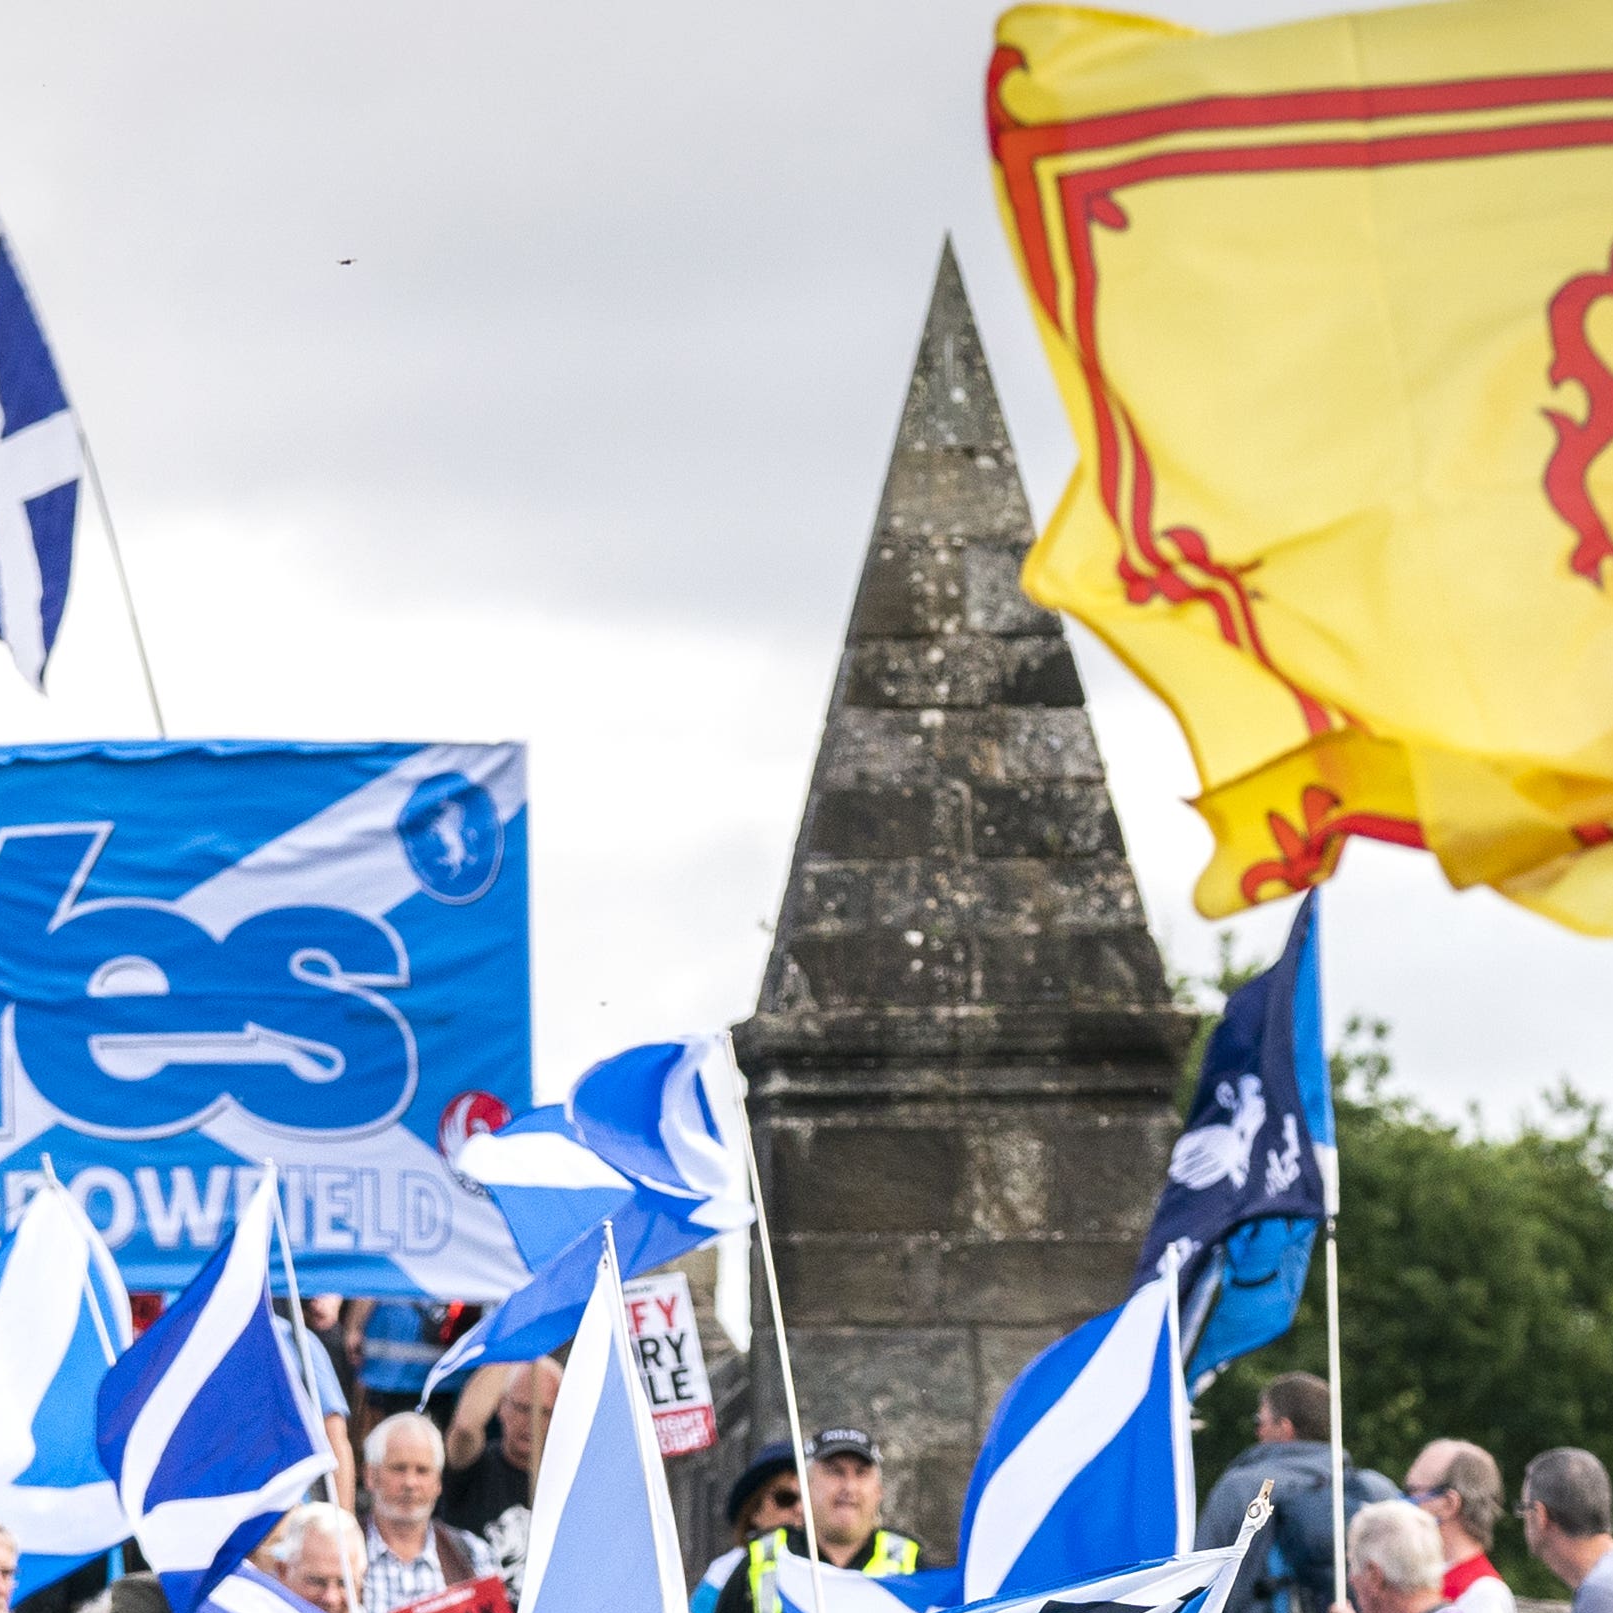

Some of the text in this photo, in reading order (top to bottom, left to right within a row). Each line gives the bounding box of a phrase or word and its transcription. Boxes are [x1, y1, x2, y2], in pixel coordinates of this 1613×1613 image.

[630, 1296, 678, 1332] FY
[638, 1332, 686, 1369] RY
[648, 1368, 694, 1404] LE
